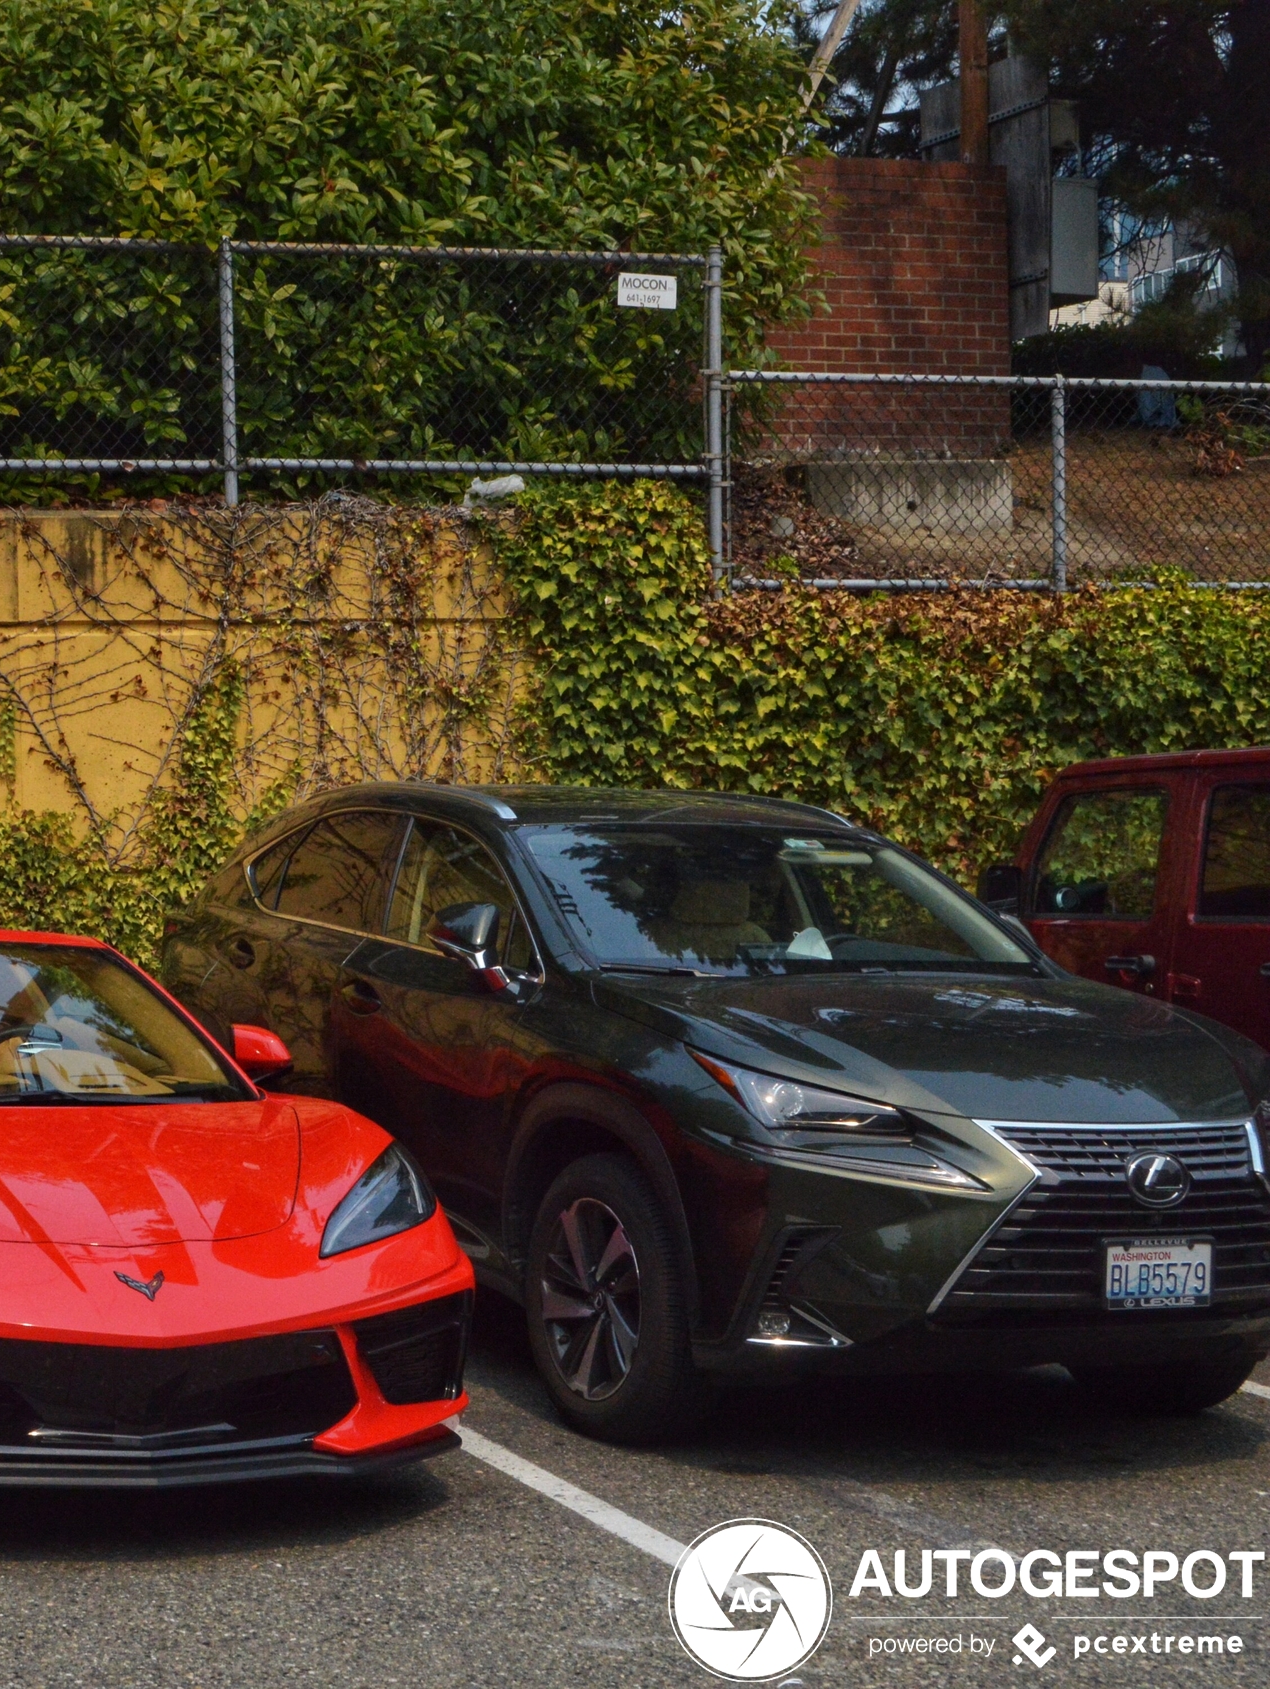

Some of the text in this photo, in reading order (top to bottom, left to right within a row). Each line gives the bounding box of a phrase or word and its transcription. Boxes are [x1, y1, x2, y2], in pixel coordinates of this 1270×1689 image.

[622, 277, 668, 291] MOCON
[626, 294, 661, 304] 641-1697
[1112, 1251, 1171, 1262] WASHINGTON
[1110, 1262, 1206, 1297] BLB5579
[1140, 1296, 1195, 1307] LEXUS
